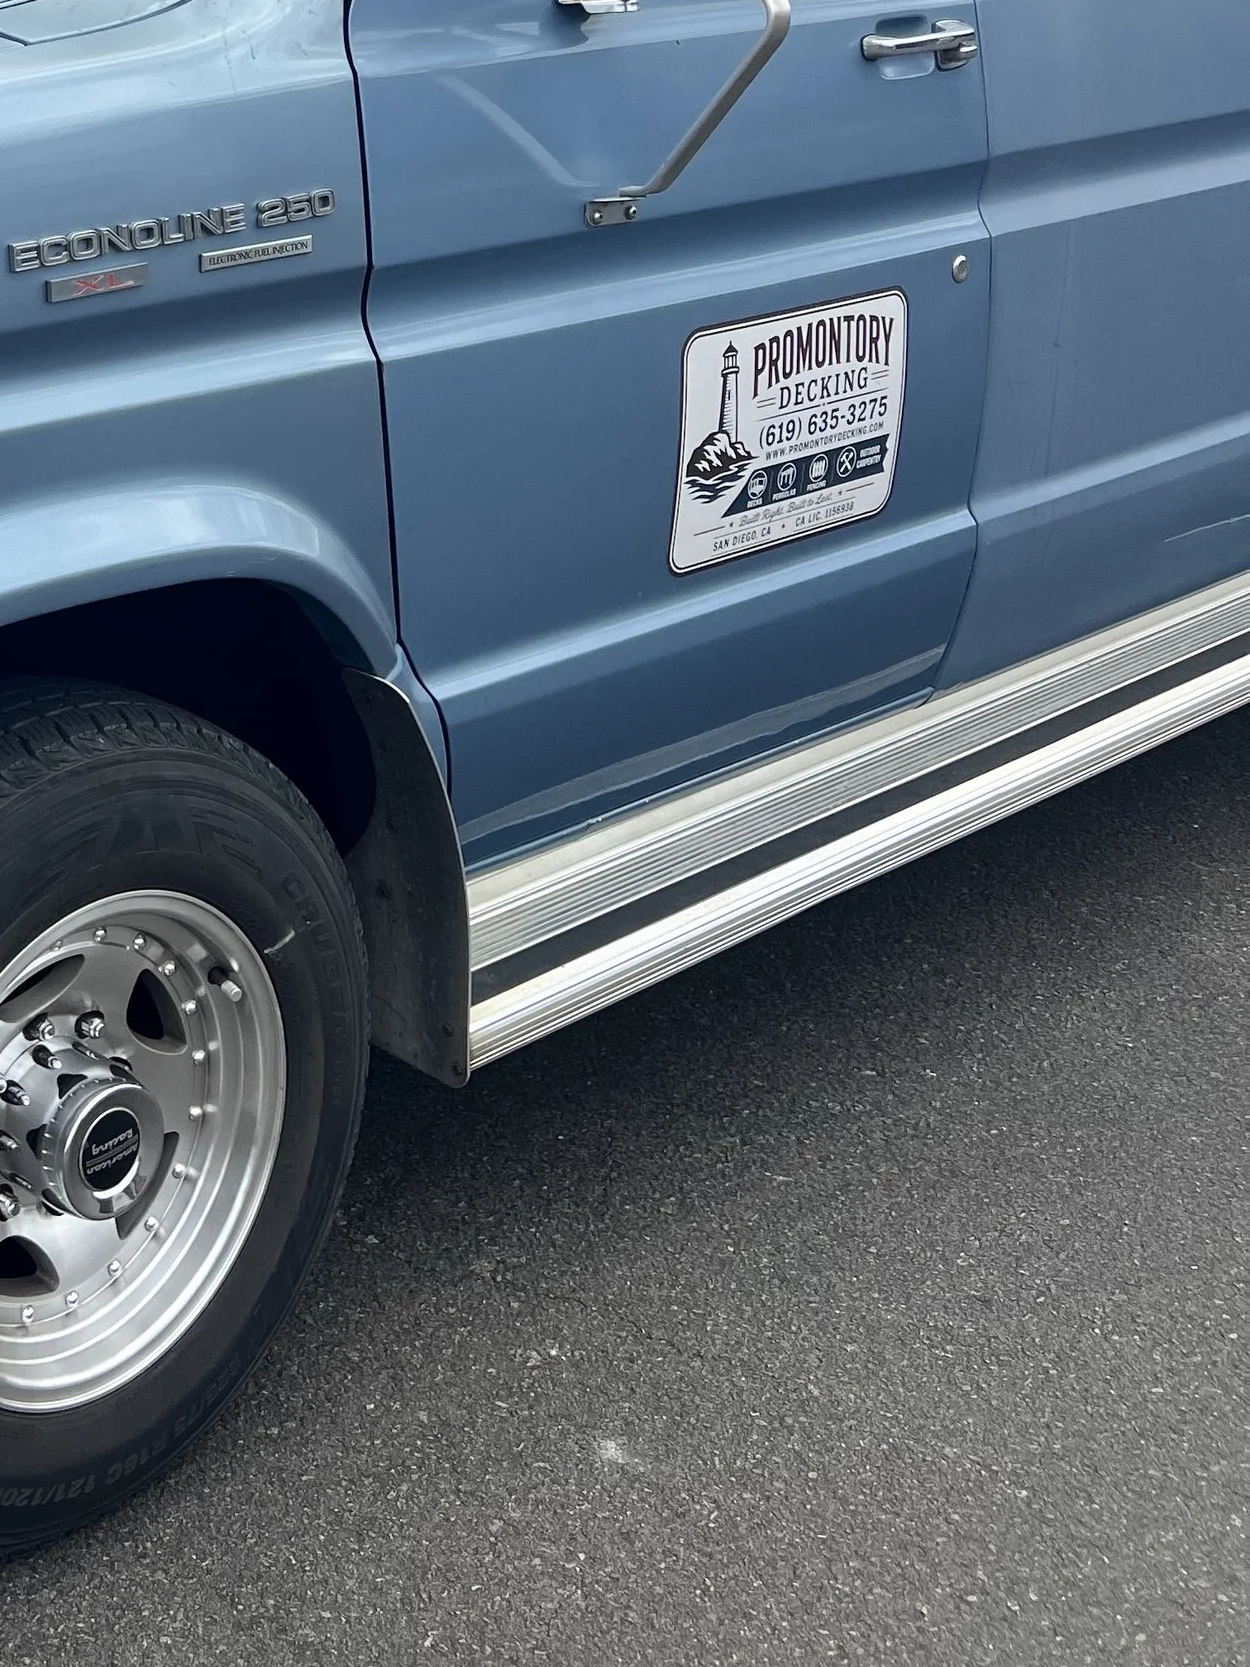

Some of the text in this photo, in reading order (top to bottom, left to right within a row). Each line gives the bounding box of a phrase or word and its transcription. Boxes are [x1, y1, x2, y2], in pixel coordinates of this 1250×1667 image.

[8, 186, 336, 273] ECONOLINE 250
[208, 240, 309, 266] ELECTRONIC FUEL INJECTION
[74, 271, 135, 296] XL
[751, 313, 894, 401] PROMONTORY
[778, 366, 869, 410] DECKING
[759, 395, 888, 450] (619) 635-3275
[765, 421, 884, 461] WWW.PROMONTORYDECKING.COM
[712, 538, 729, 552] SAN
[761, 525, 771, 537] CA
[795, 515, 806, 527] CA
